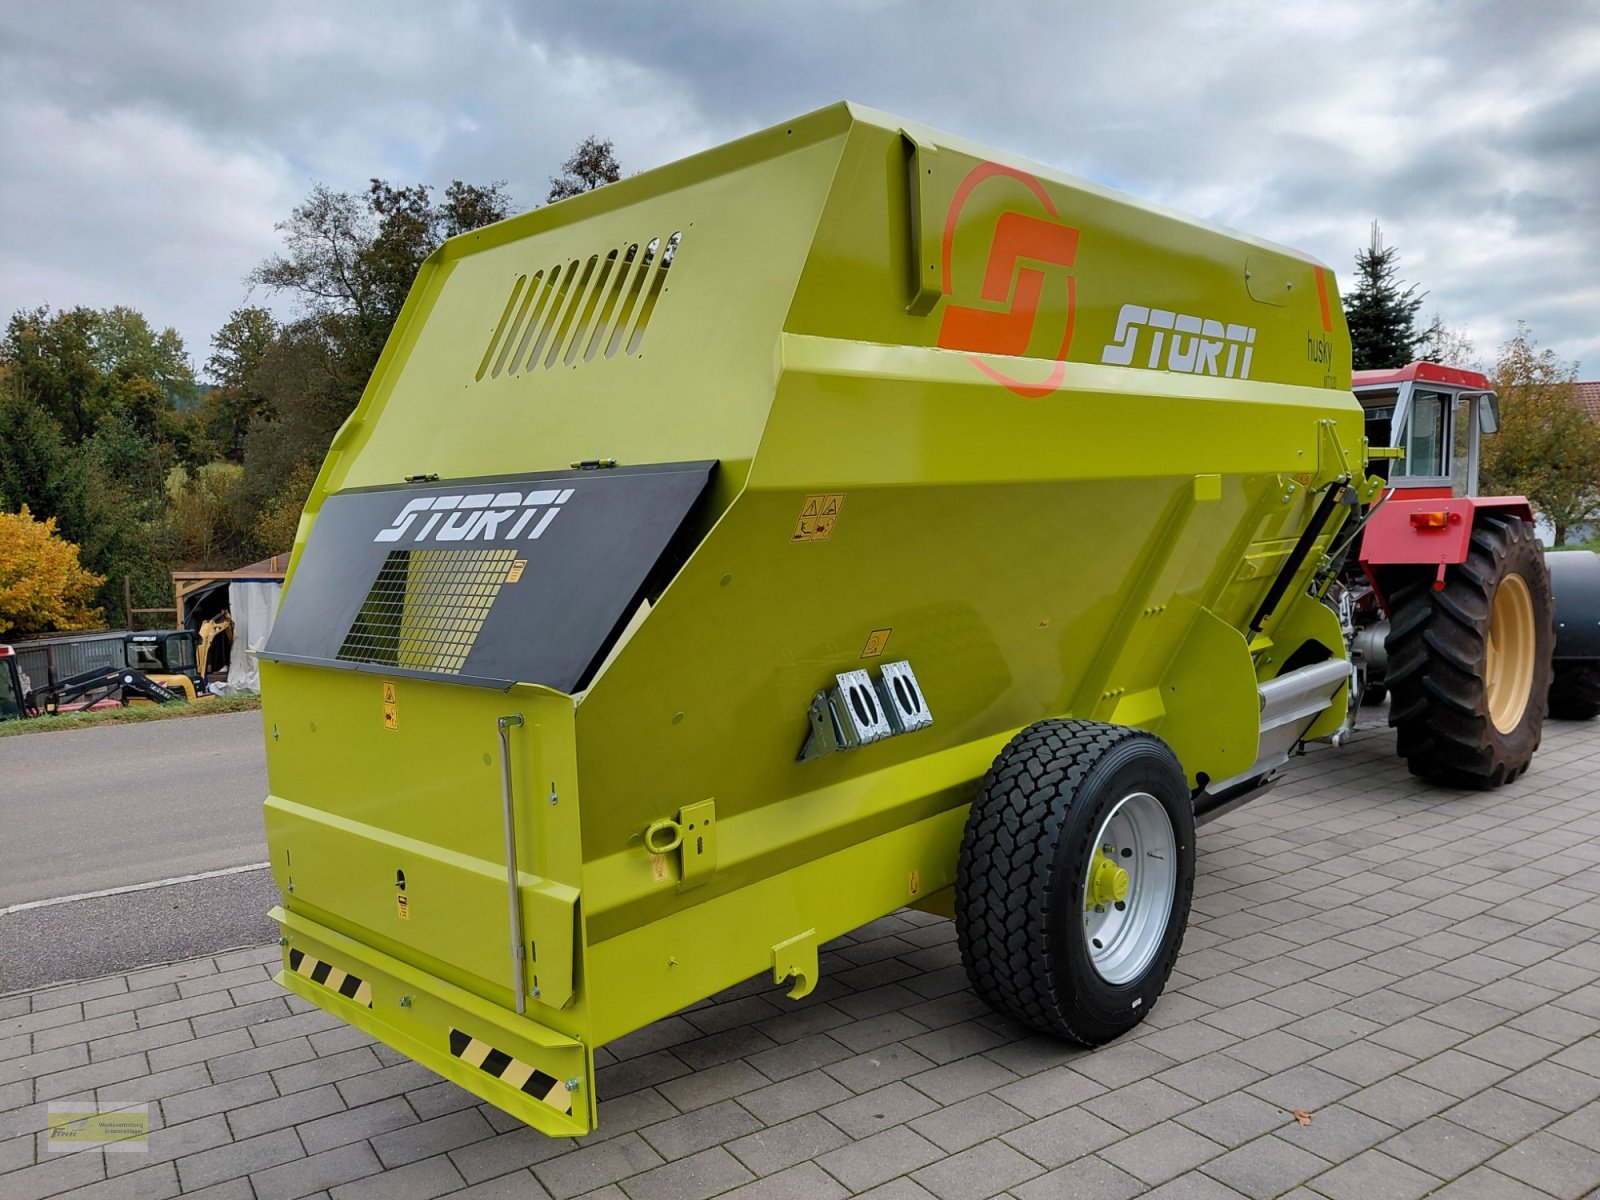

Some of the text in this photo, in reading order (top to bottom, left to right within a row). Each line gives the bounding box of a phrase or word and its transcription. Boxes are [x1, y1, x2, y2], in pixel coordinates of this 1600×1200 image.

[1101, 303, 1257, 380] STORTI
[1307, 329, 1333, 372] husky
[373, 488, 576, 542] STORTI
